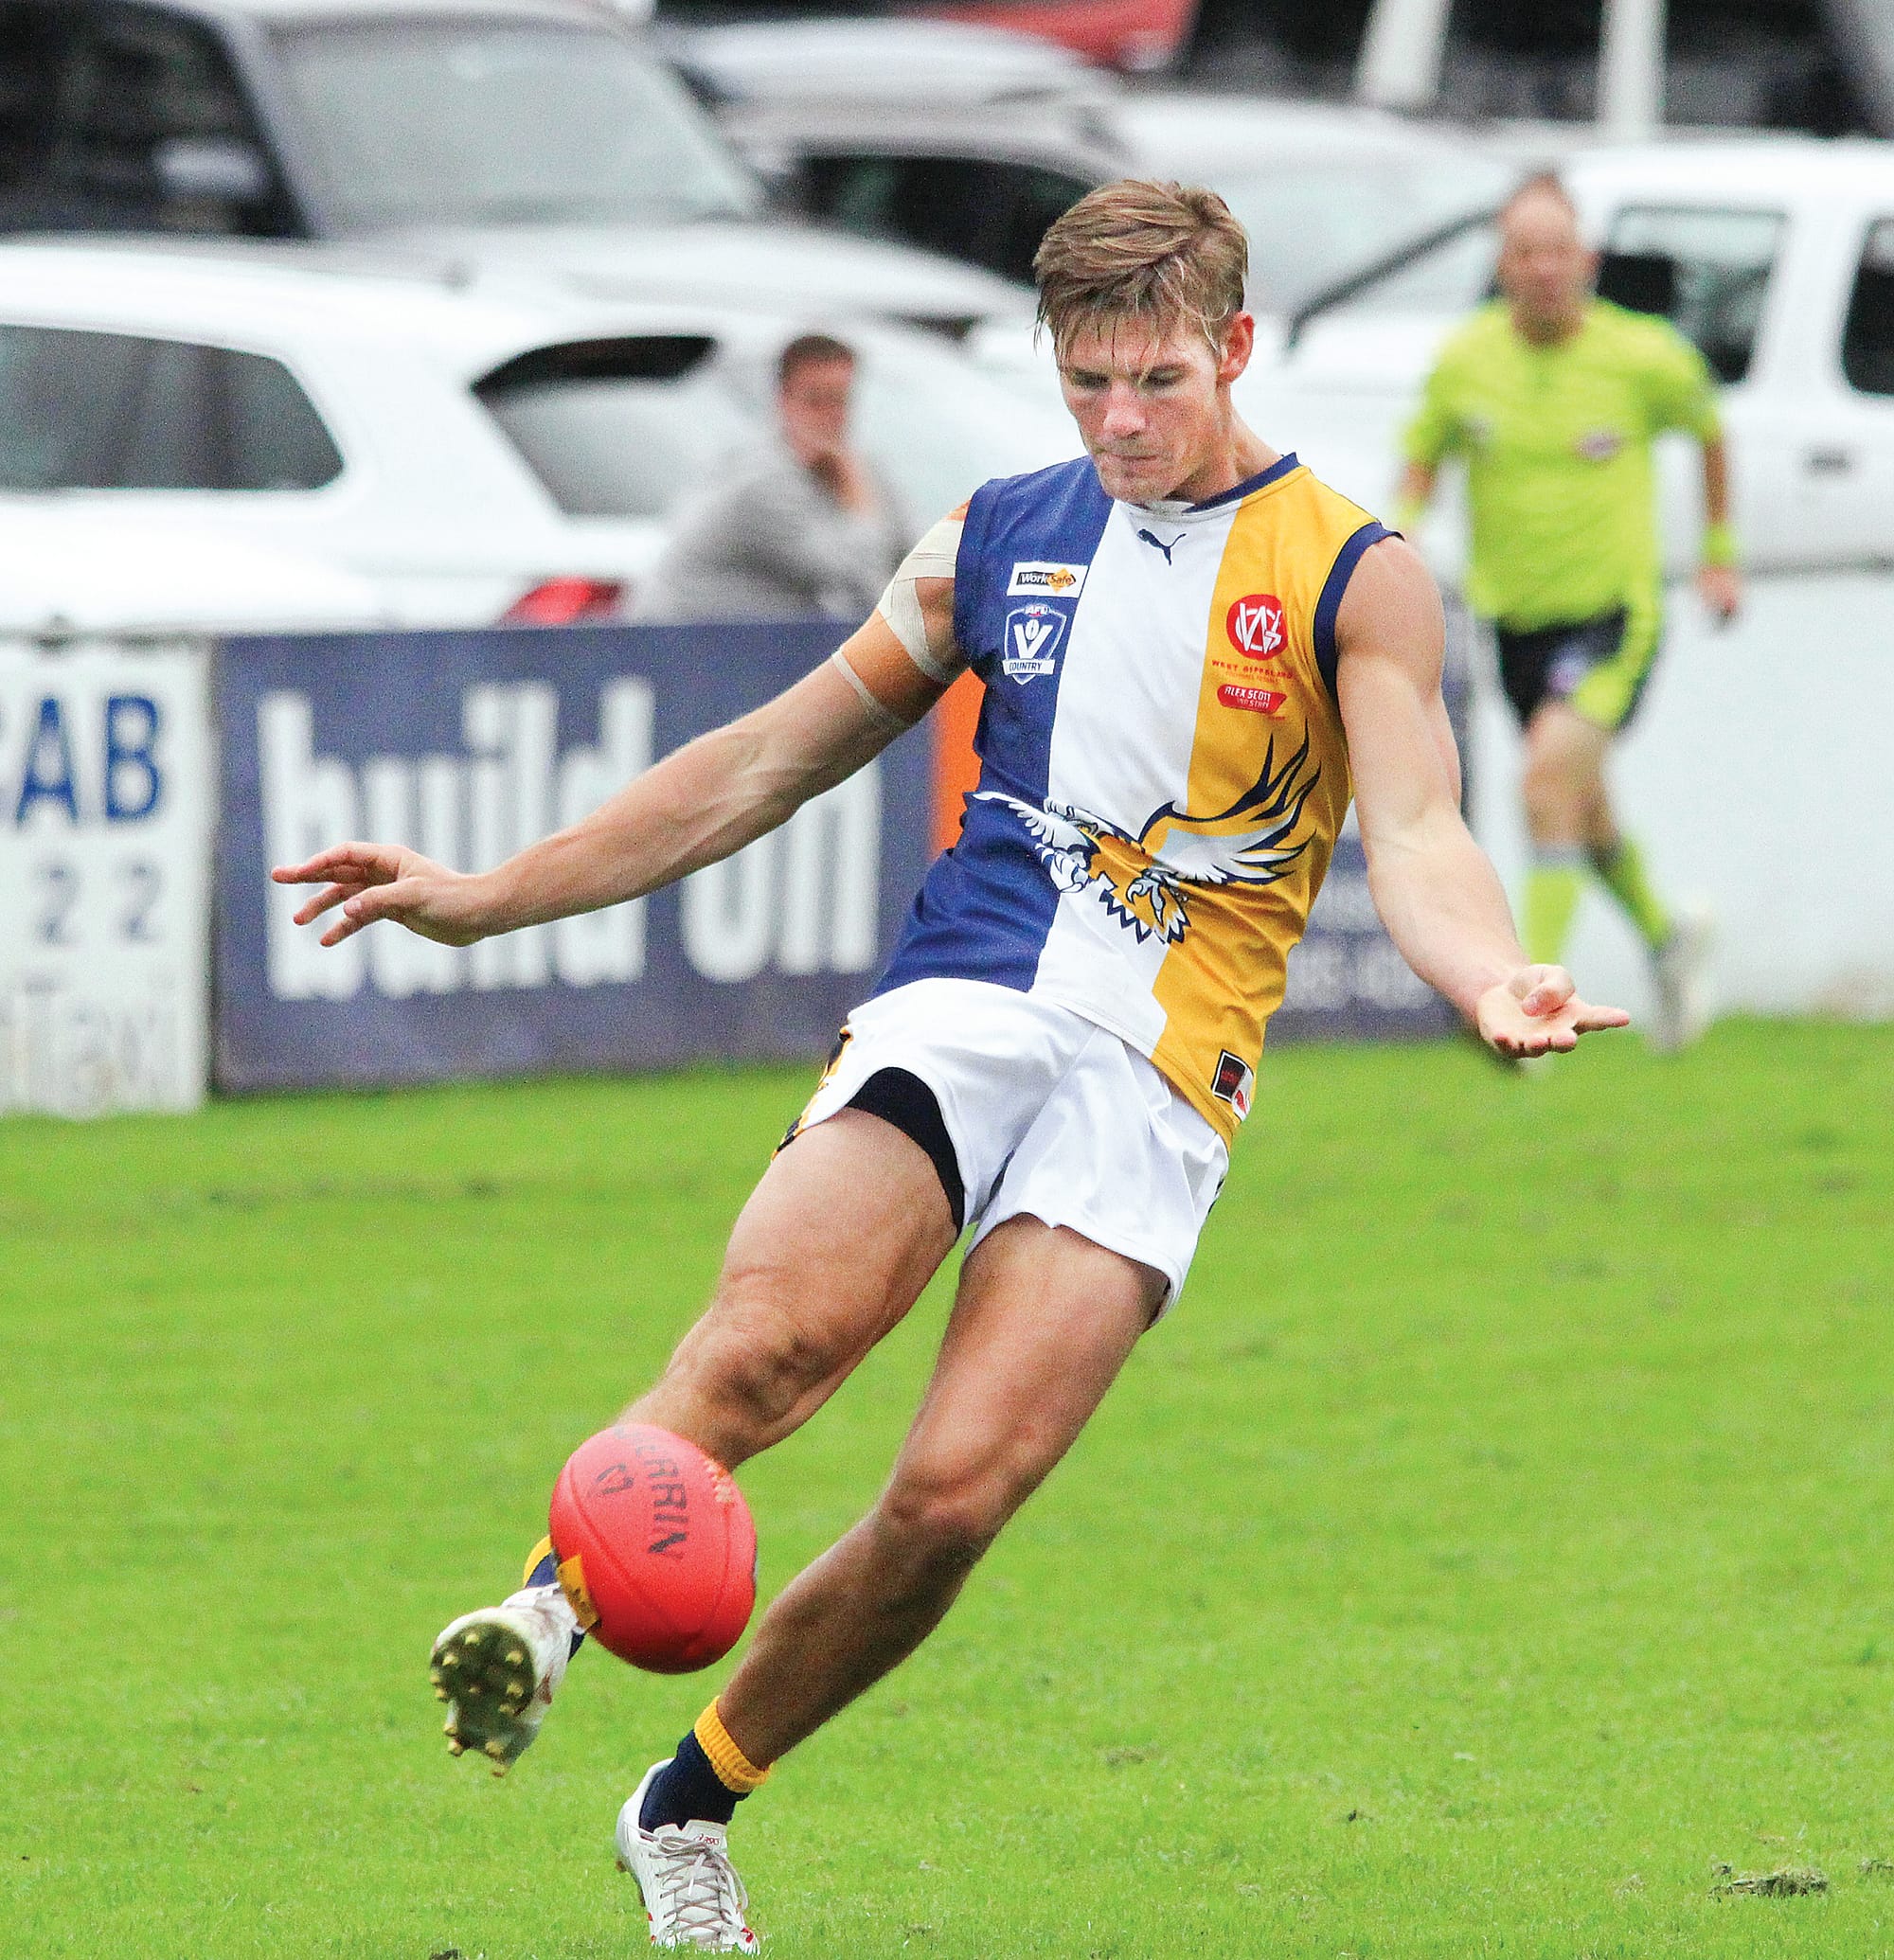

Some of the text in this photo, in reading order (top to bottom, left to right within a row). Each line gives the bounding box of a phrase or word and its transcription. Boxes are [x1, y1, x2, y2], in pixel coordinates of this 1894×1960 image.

[1009, 662, 1042, 671] COUNTRY
[1224, 686, 1272, 703] ALEX SCOTT
[0, 696, 160, 824] AB
[258, 678, 655, 1001] build
